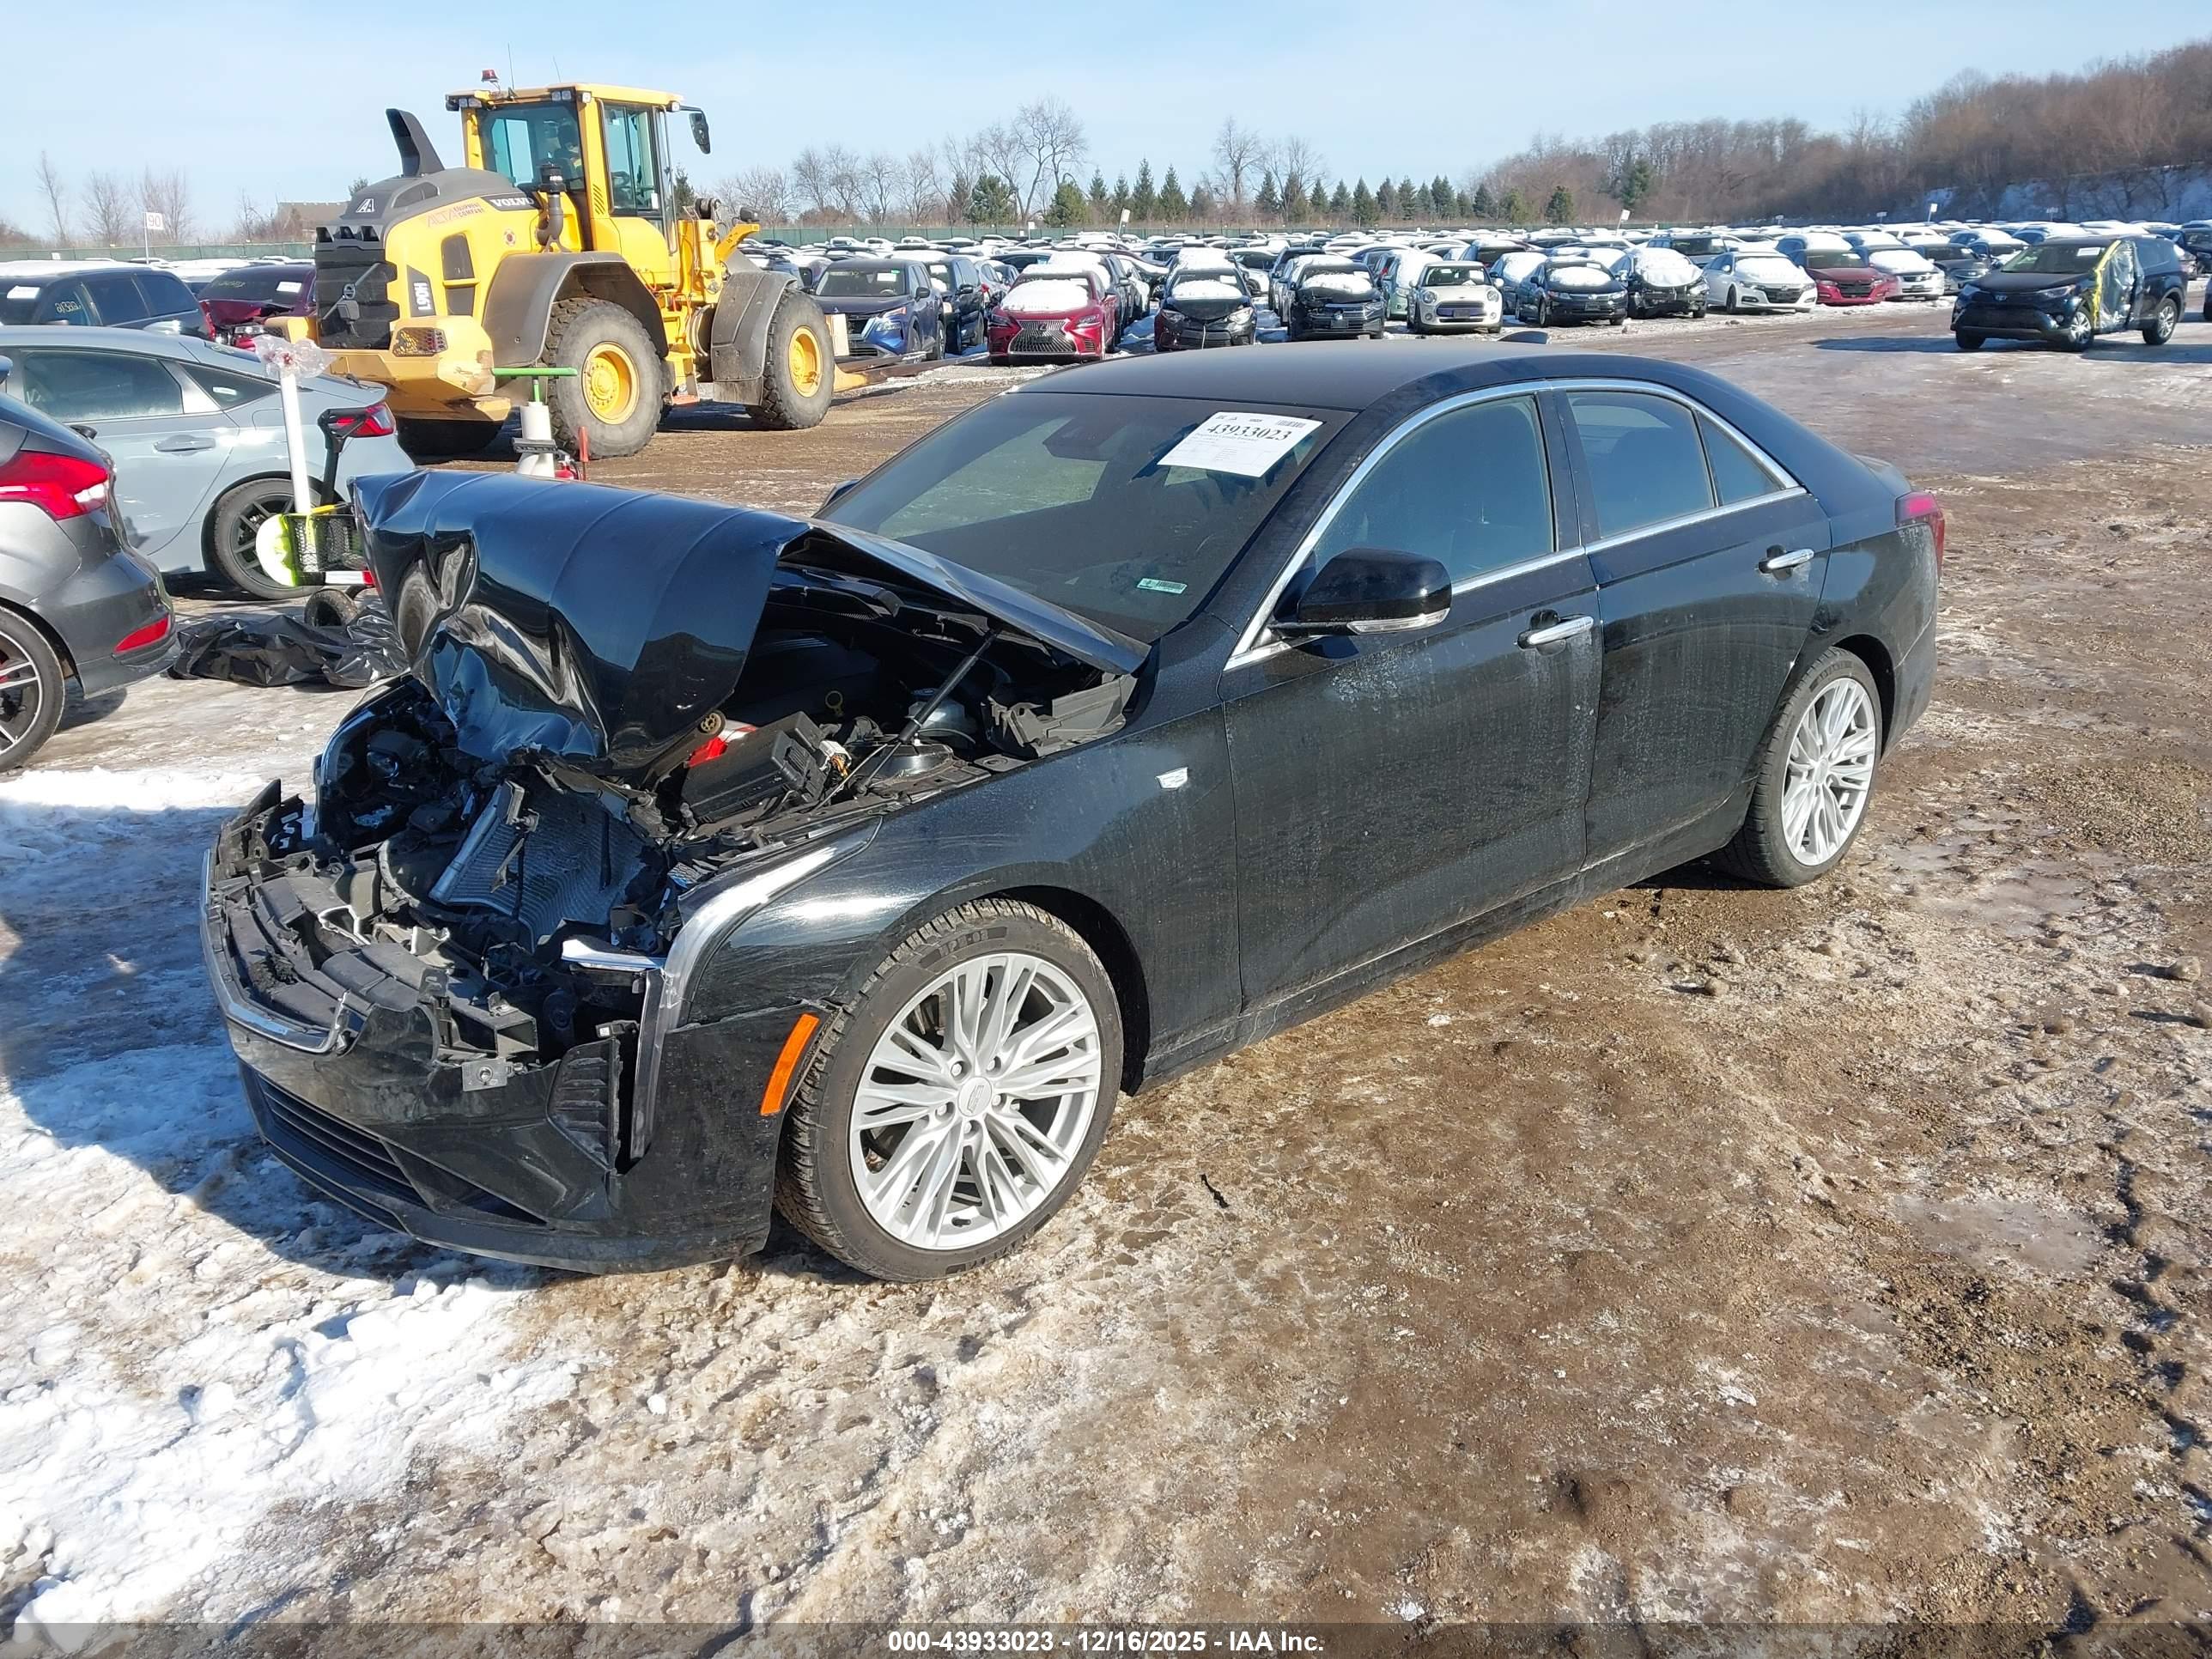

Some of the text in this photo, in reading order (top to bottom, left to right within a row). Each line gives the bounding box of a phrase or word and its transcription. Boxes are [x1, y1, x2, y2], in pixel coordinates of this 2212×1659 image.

[489, 198, 534, 207] VOLVO
[148, 214, 161, 228] 90
[413, 282, 432, 311] L90H
[1207, 423, 1292, 441] 43933023
